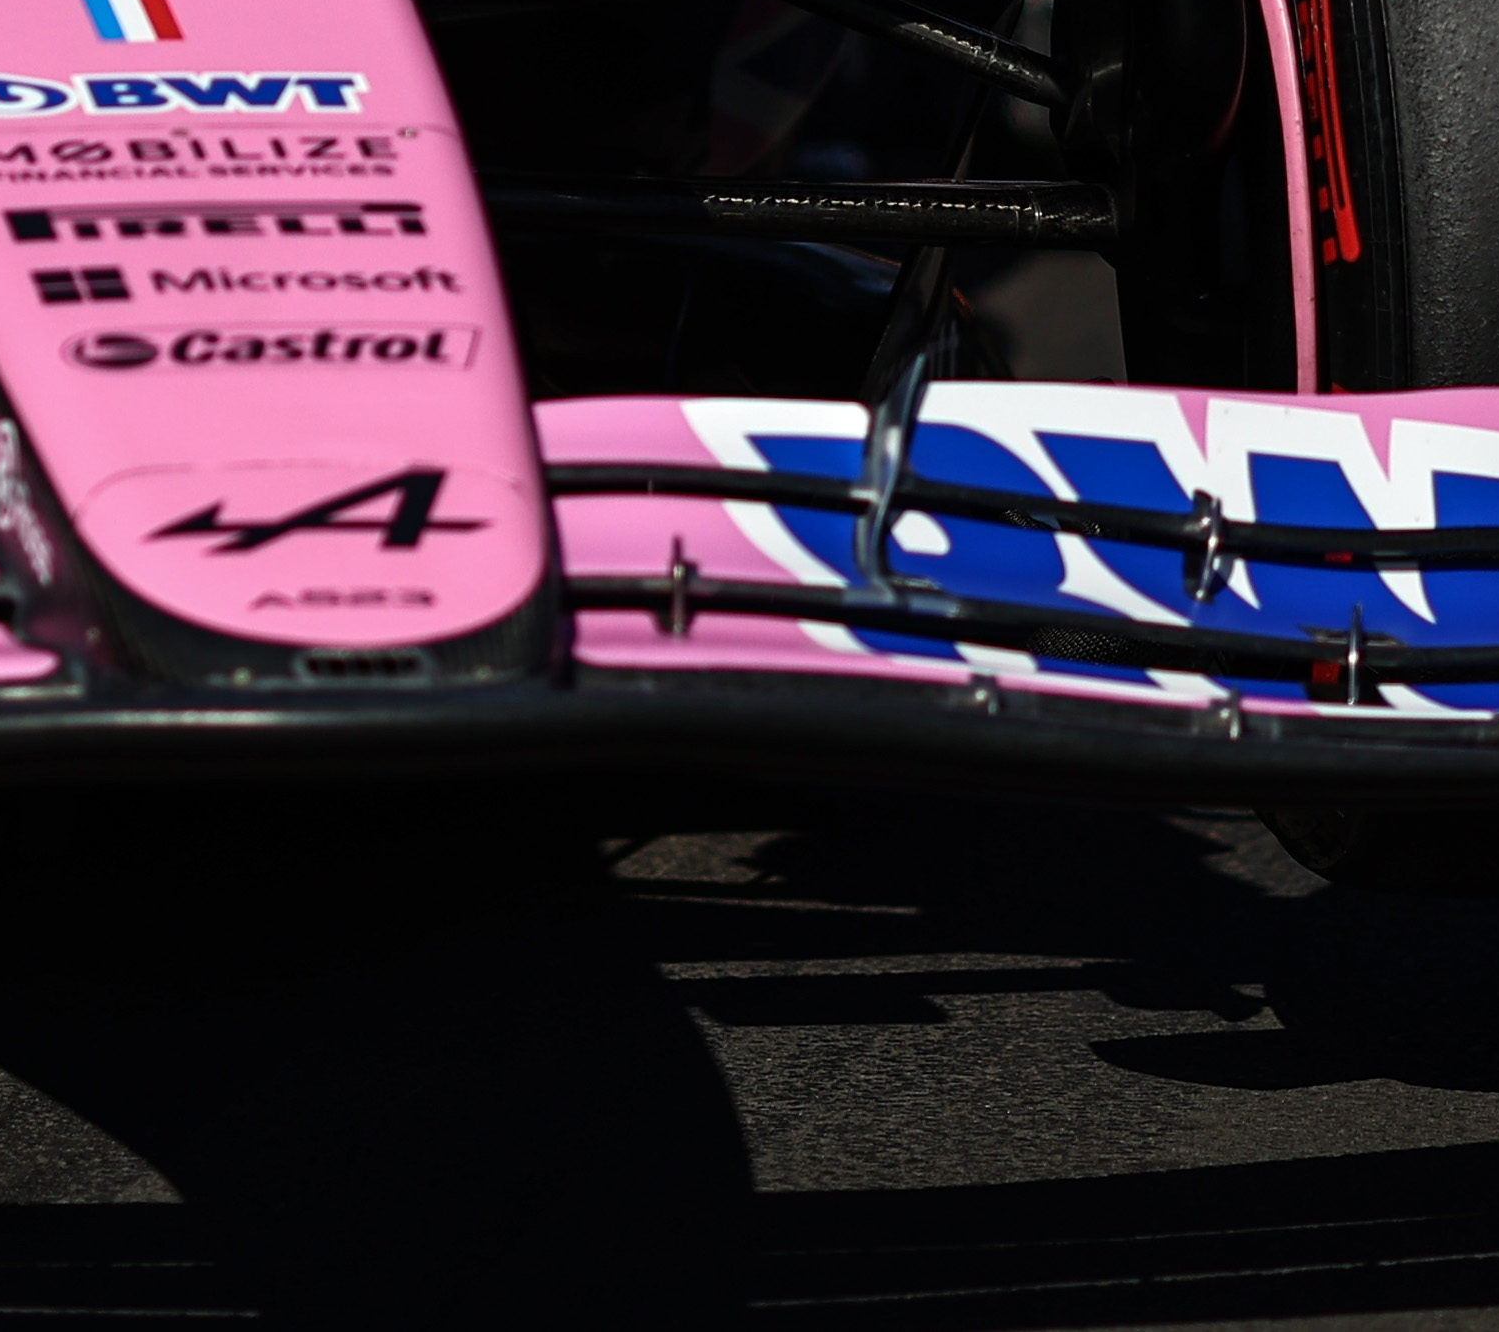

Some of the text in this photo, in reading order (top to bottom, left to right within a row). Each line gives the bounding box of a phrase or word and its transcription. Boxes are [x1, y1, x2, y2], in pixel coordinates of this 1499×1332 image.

[75, 72, 370, 114] BWT
[209, 162, 396, 179] SERVICES
[3, 200, 428, 242] PIRELLI
[149, 267, 463, 295] Microsoft
[170, 329, 450, 365] Castrol
